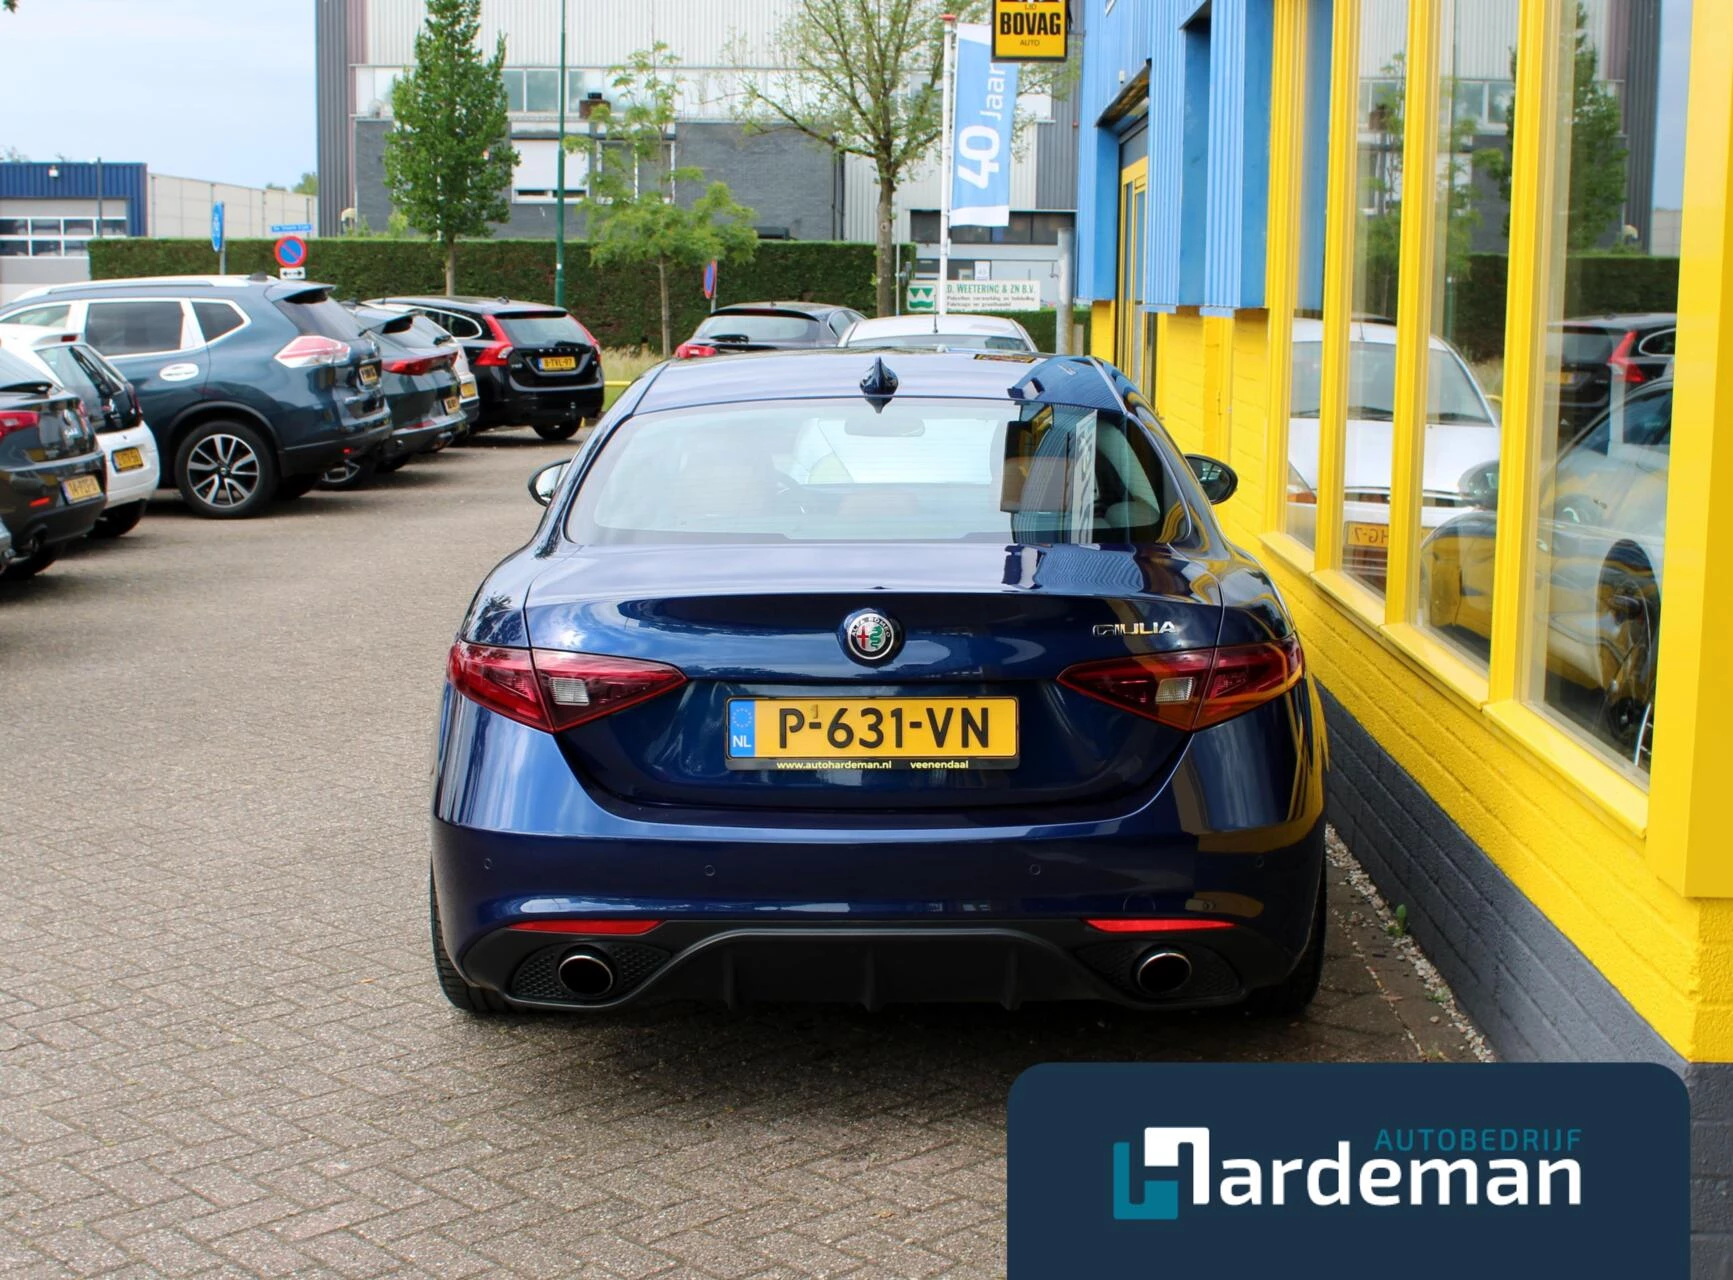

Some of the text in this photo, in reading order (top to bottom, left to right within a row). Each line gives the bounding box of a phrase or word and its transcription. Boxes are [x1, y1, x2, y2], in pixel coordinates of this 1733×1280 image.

[1000, 12, 1061, 36] BOVAG
[1020, 39, 1041, 47] AUTO
[957, 125, 1001, 189] 40
[1092, 620, 1176, 636] GIULIA
[779, 707, 990, 749] P-631-VN
[732, 736, 752, 748] NL
[776, 759, 969, 769] www.autohardeman.nl veenendaal
